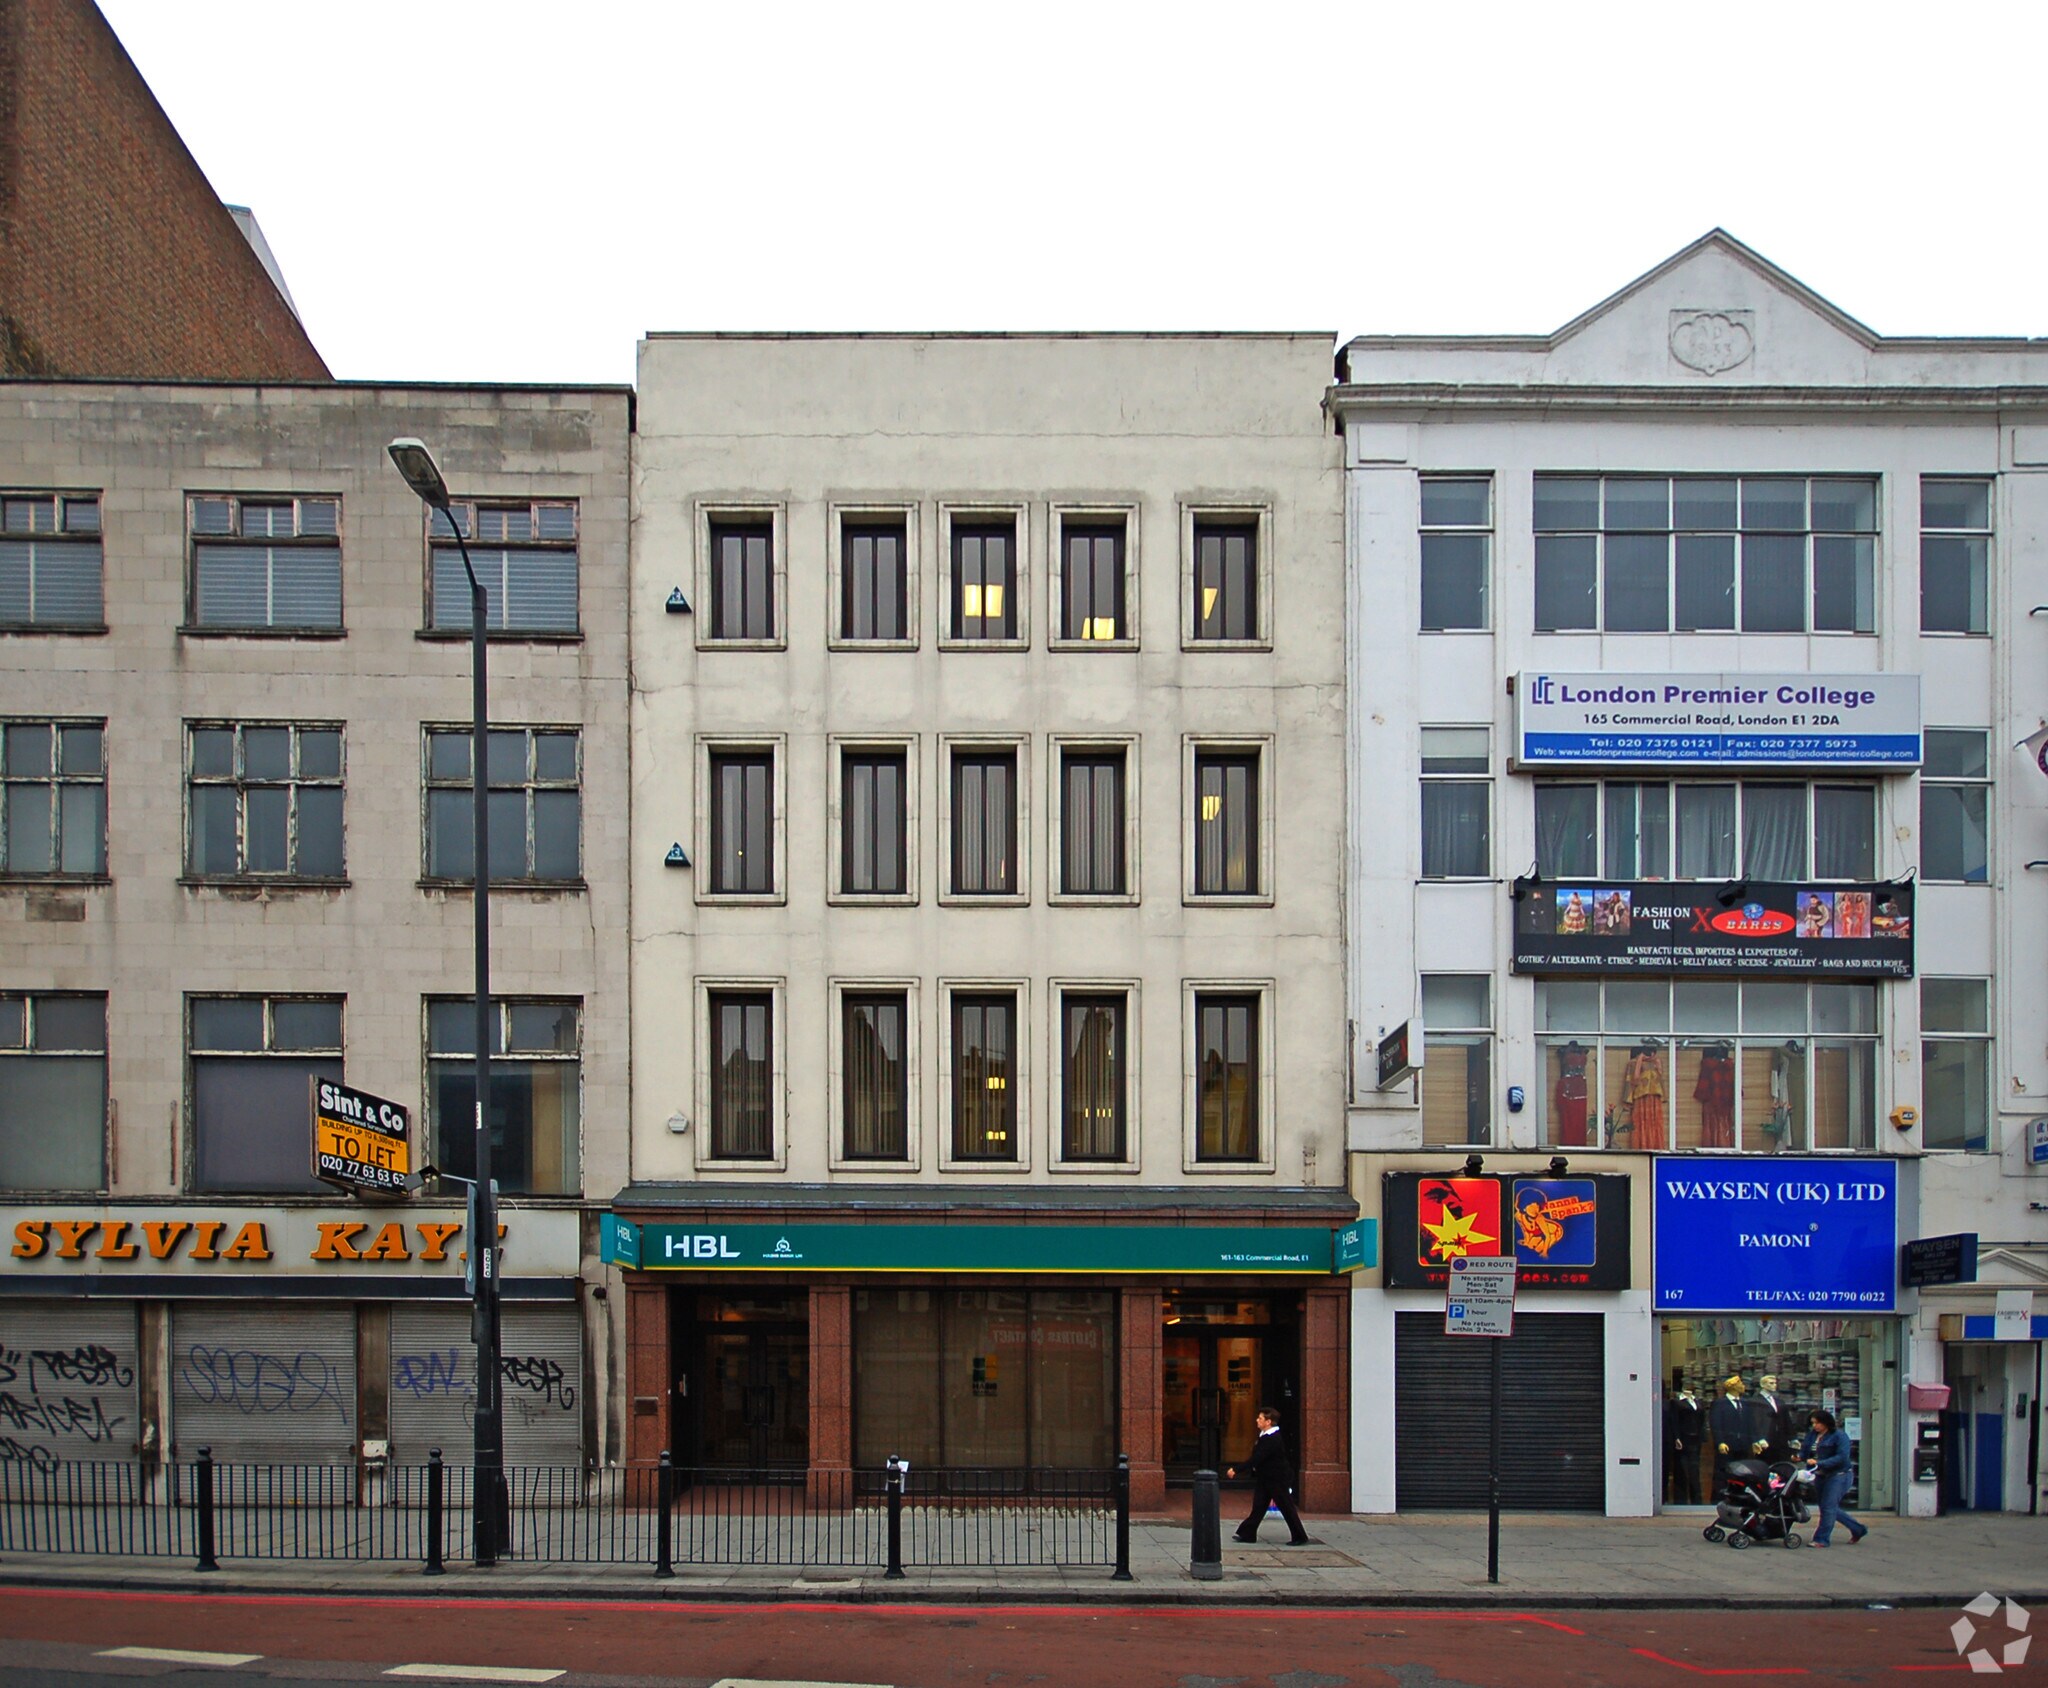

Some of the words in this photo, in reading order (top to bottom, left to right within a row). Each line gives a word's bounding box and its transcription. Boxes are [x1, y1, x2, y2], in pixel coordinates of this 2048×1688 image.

[1561, 685, 1656, 704] London
[1663, 686, 1769, 704] Premier
[1776, 686, 1876, 709] College
[1583, 713, 1608, 725] 165
[1612, 713, 1692, 726] Commercial
[1695, 714, 1735, 727] Road,
[1738, 714, 1788, 726] London
[1792, 715, 1806, 726] E1
[1811, 715, 1840, 726] 2DA
[1588, 738, 1613, 748] Tel:
[1617, 739, 1642, 748] 020
[1645, 739, 1679, 748] 7375
[1681, 739, 1714, 748] 0121
[1727, 739, 1756, 749] Fax:
[1760, 740, 1785, 749] 020
[1788, 740, 1821, 749] 7377
[1824, 740, 1858, 749] 5973
[1632, 906, 1692, 918] FASHION
[1689, 907, 1714, 933] X
[1652, 918, 1672, 930] UK
[1518, 955, 1545, 965] GOTHIC
[1551, 955, 1602, 965] ALTERNATIVE
[1607, 956, 1634, 966] ETHNIC
[1682, 956, 1707, 967] BELLY
[1707, 957, 1733, 967] DANCE
[1737, 957, 1769, 967] INCENSE
[1773, 957, 1817, 967] JEWELLERY
[1823, 959, 1844, 968] BAGS
[1845, 959, 1861, 968] AND
[1695, 947, 1737, 957] IMPORTERS
[1745, 948, 1788, 958] EXPORTERS
[320, 1083, 362, 1119] Sint
[366, 1105, 378, 1124] &
[379, 1104, 404, 1132] Co
[321, 1119, 353, 1134] BUILDING
[353, 1128, 363, 1136] UP
[364, 1130, 373, 1139] TO
[331, 1133, 360, 1160] TO
[366, 1142, 396, 1169] LET
[321, 1154, 343, 1171] 020
[346, 1160, 360, 1175] 77
[362, 1164, 375, 1179] 63
[377, 1169, 390, 1183] 63
[1665, 1181, 1770, 1201] WAYSEN
[1776, 1182, 1831, 1205] (UK)
[1836, 1182, 1886, 1202] LTD
[1550, 1202, 1594, 1220] Spank?
[10, 1220, 271, 1260] SYLVIA
[310, 1221, 507, 1260] KAY
[617, 1224, 633, 1242] HBL
[1342, 1229, 1360, 1247] HBL
[1738, 1233, 1811, 1248] PAMONI
[665, 1234, 742, 1258] HBL
[1910, 1237, 1961, 1255] WAYSEN
[1664, 1289, 1684, 1300] 167
[1745, 1290, 1806, 1302] TEL/FAX:
[1807, 1291, 1828, 1301] 020
[1831, 1291, 1857, 1302] 7790
[1859, 1292, 1886, 1302] 6022
